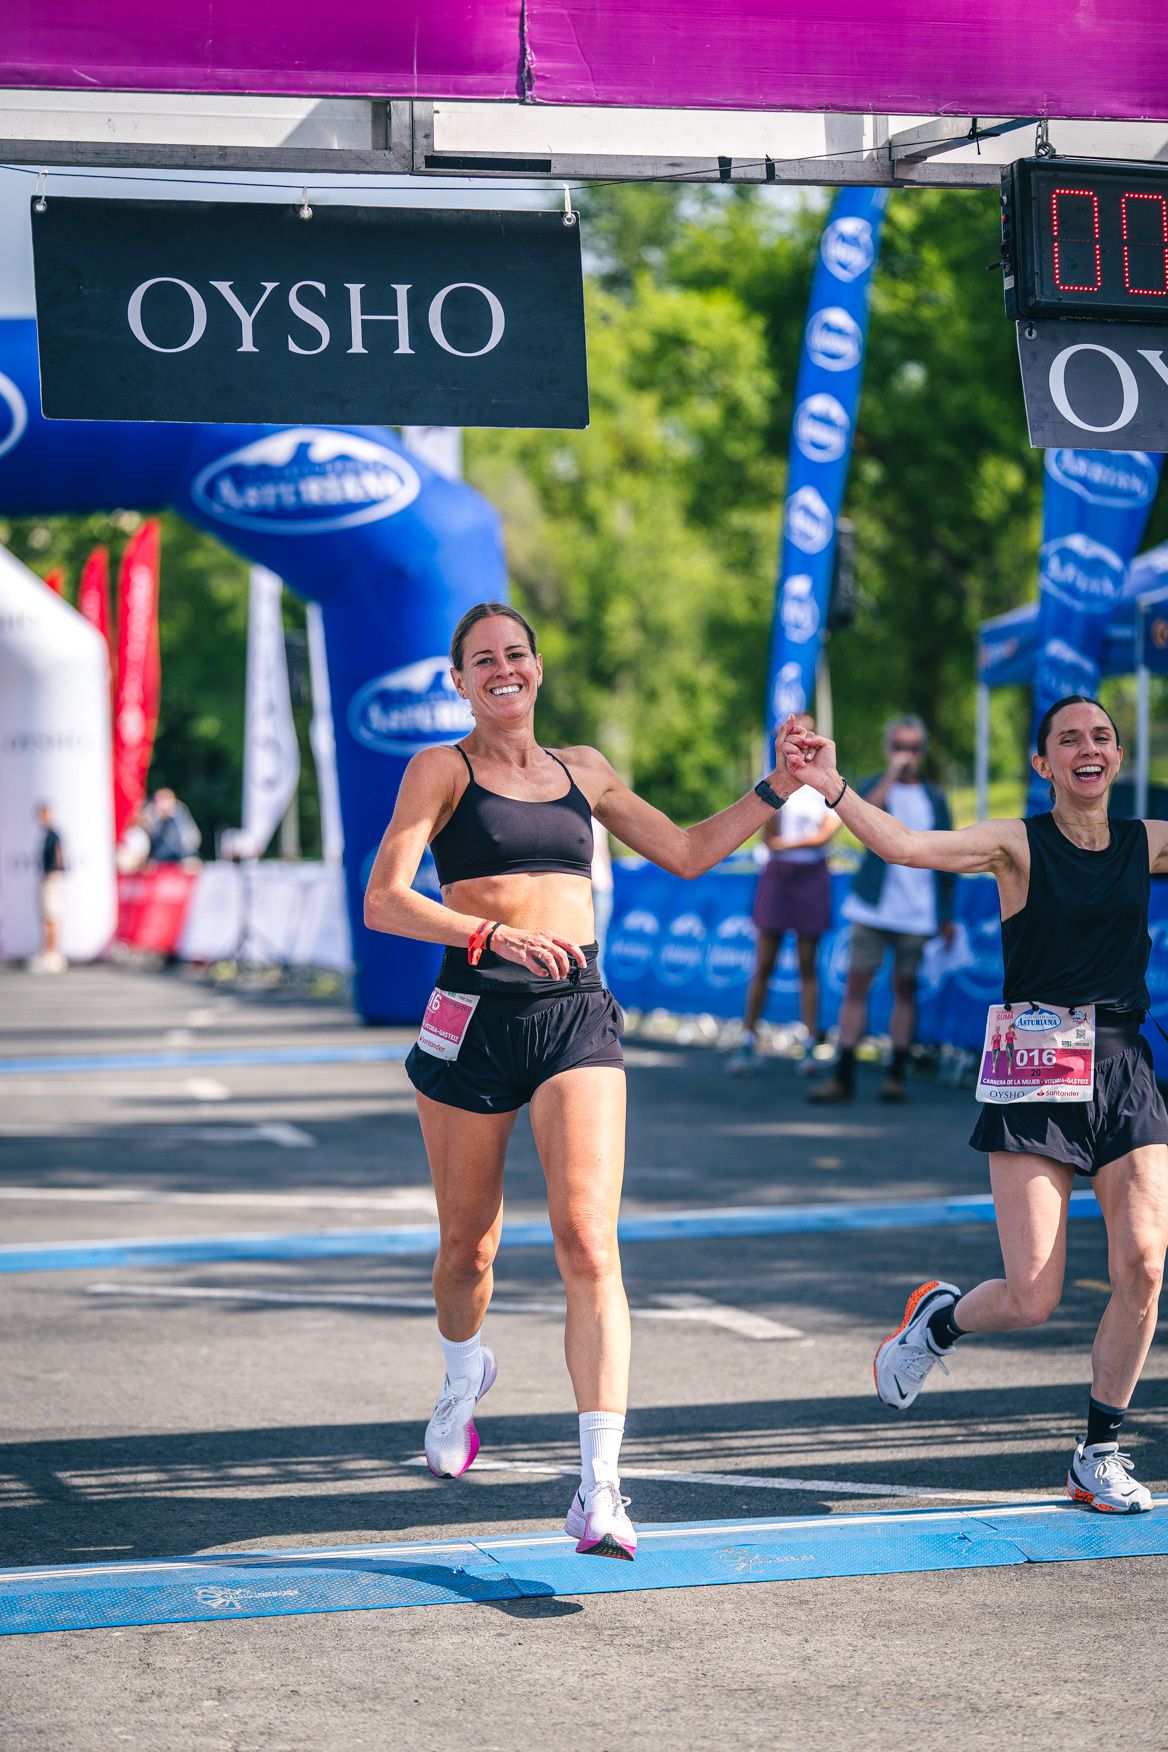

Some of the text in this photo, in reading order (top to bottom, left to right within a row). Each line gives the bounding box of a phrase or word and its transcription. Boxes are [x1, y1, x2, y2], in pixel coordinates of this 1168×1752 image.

[127, 276, 506, 358] OYSHO
[1017, 1017, 1058, 1026] ASTURIANA
[1015, 1049, 1057, 1066] 016
[1031, 1069, 1041, 1077] 20
[989, 1090, 1025, 1099] OYSHO
